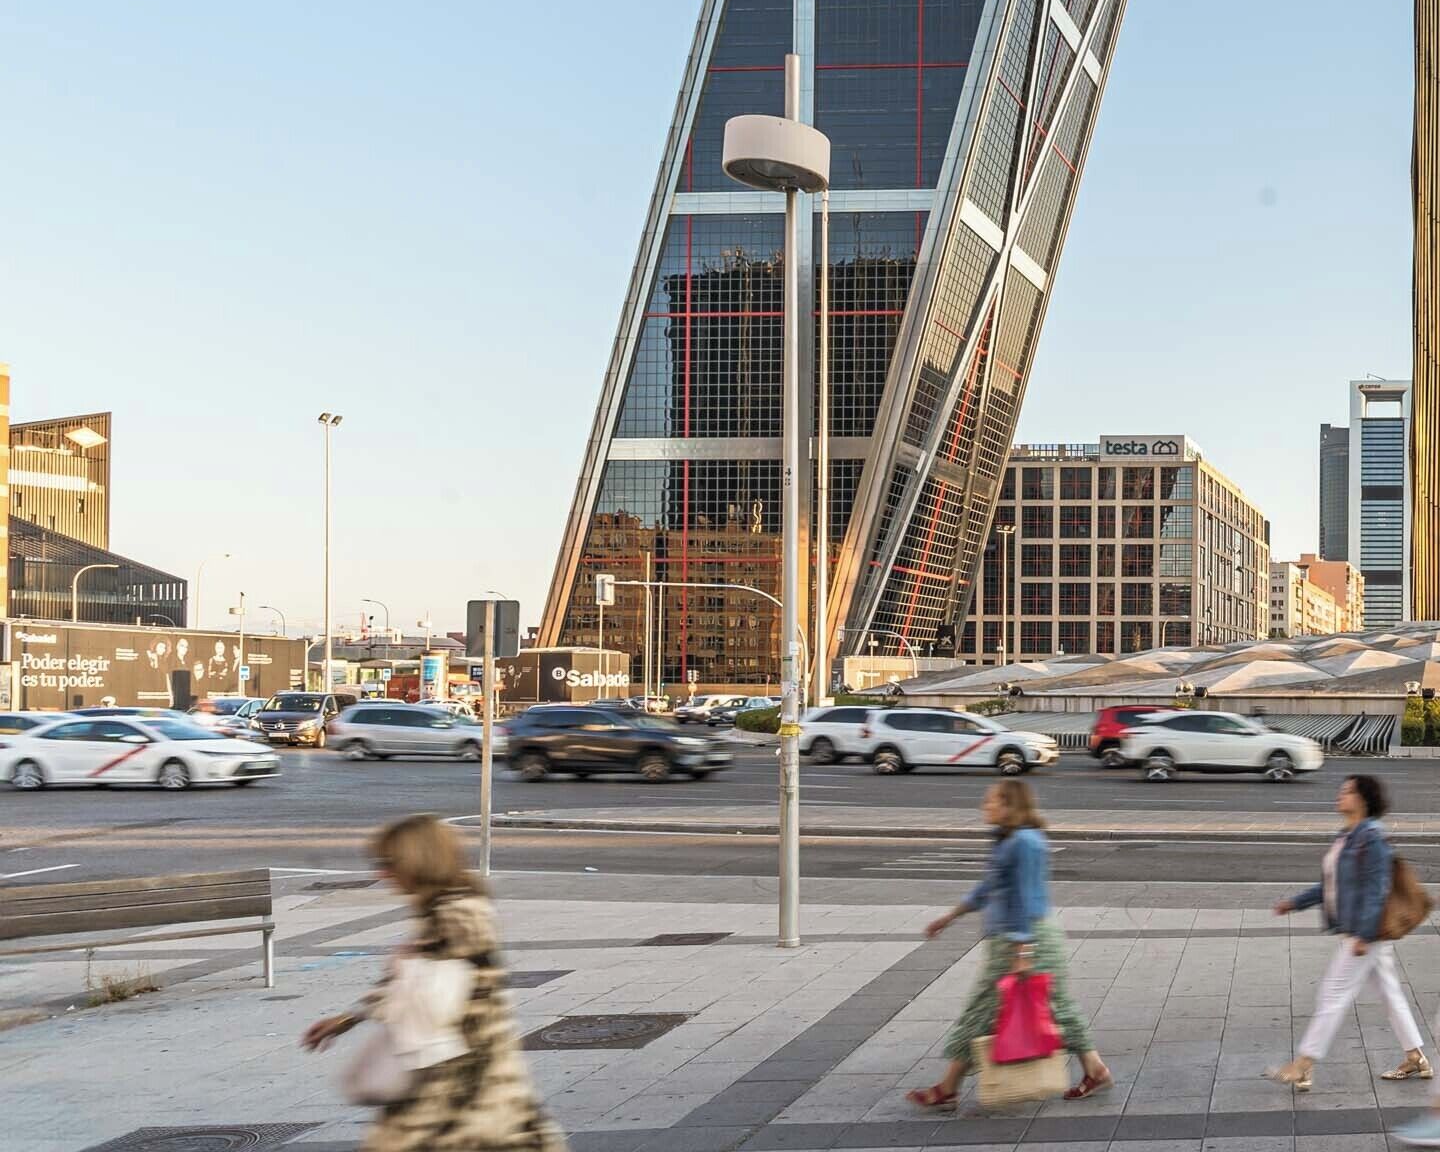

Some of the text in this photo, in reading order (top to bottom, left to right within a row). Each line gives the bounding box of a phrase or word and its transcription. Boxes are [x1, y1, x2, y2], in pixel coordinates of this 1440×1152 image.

[1106, 440, 1147, 455] testa
[21, 653, 66, 670] Poder
[67, 654, 110, 675] elegir
[21, 672, 105, 692] es tu poder.
